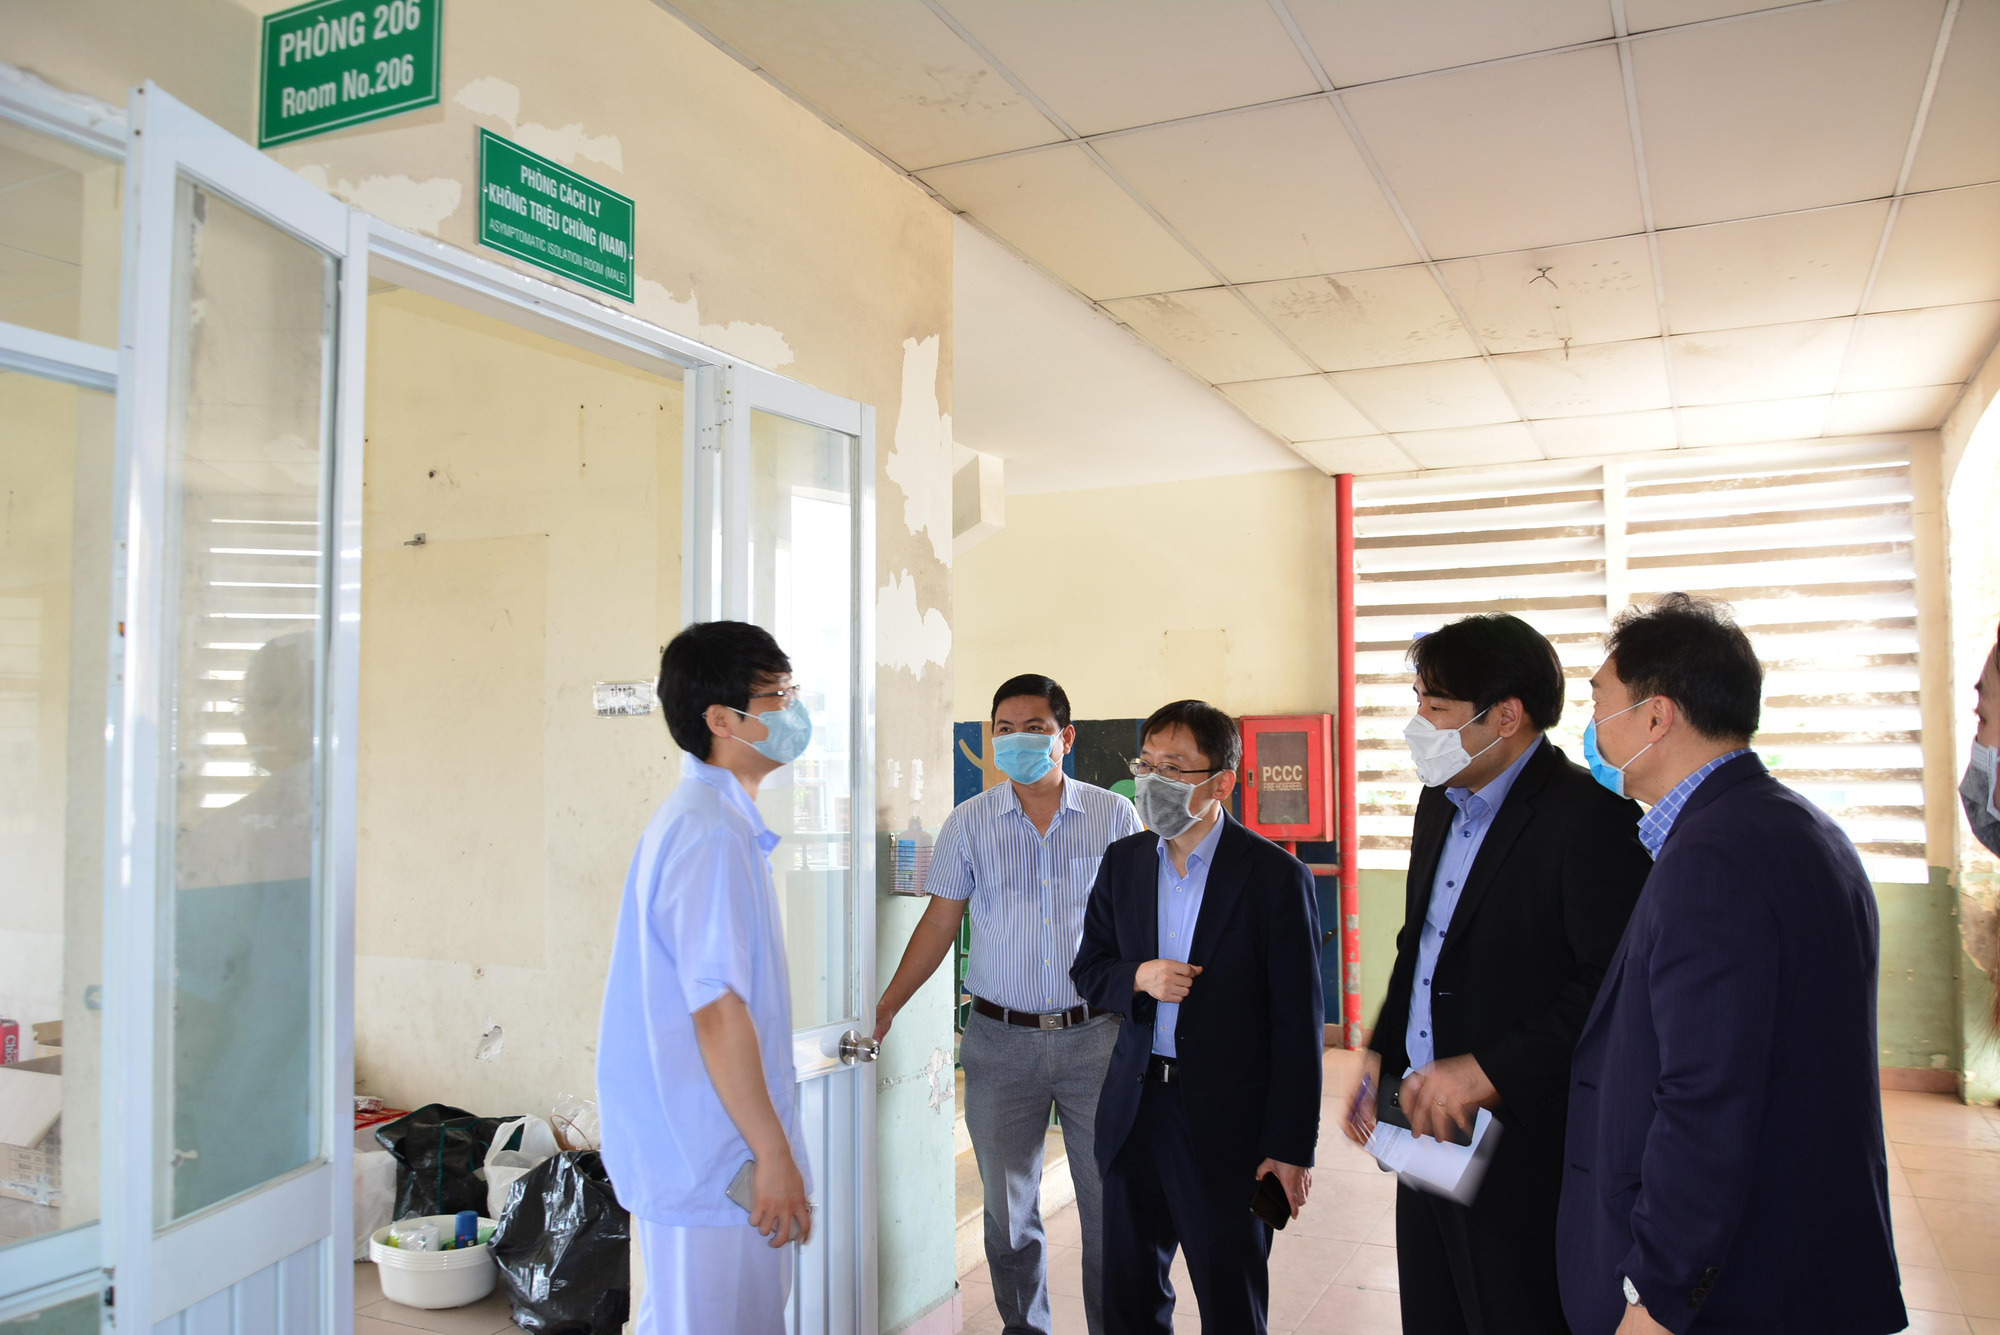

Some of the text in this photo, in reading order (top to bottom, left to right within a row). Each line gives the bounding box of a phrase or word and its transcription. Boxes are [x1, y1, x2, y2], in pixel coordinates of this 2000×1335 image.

[279, 0, 421, 67] PHÒNG 206
[281, 54, 414, 118] Room No.206
[488, 182, 627, 263] KHÔNG TRIỆU CHỨNG (NAM)
[520, 164, 601, 218] PHÒNG CÁCH LY
[489, 218, 627, 287] ASYMPTOMATIC ISOLATION ROOM (MALE)
[1262, 765, 1303, 782] PCCC
